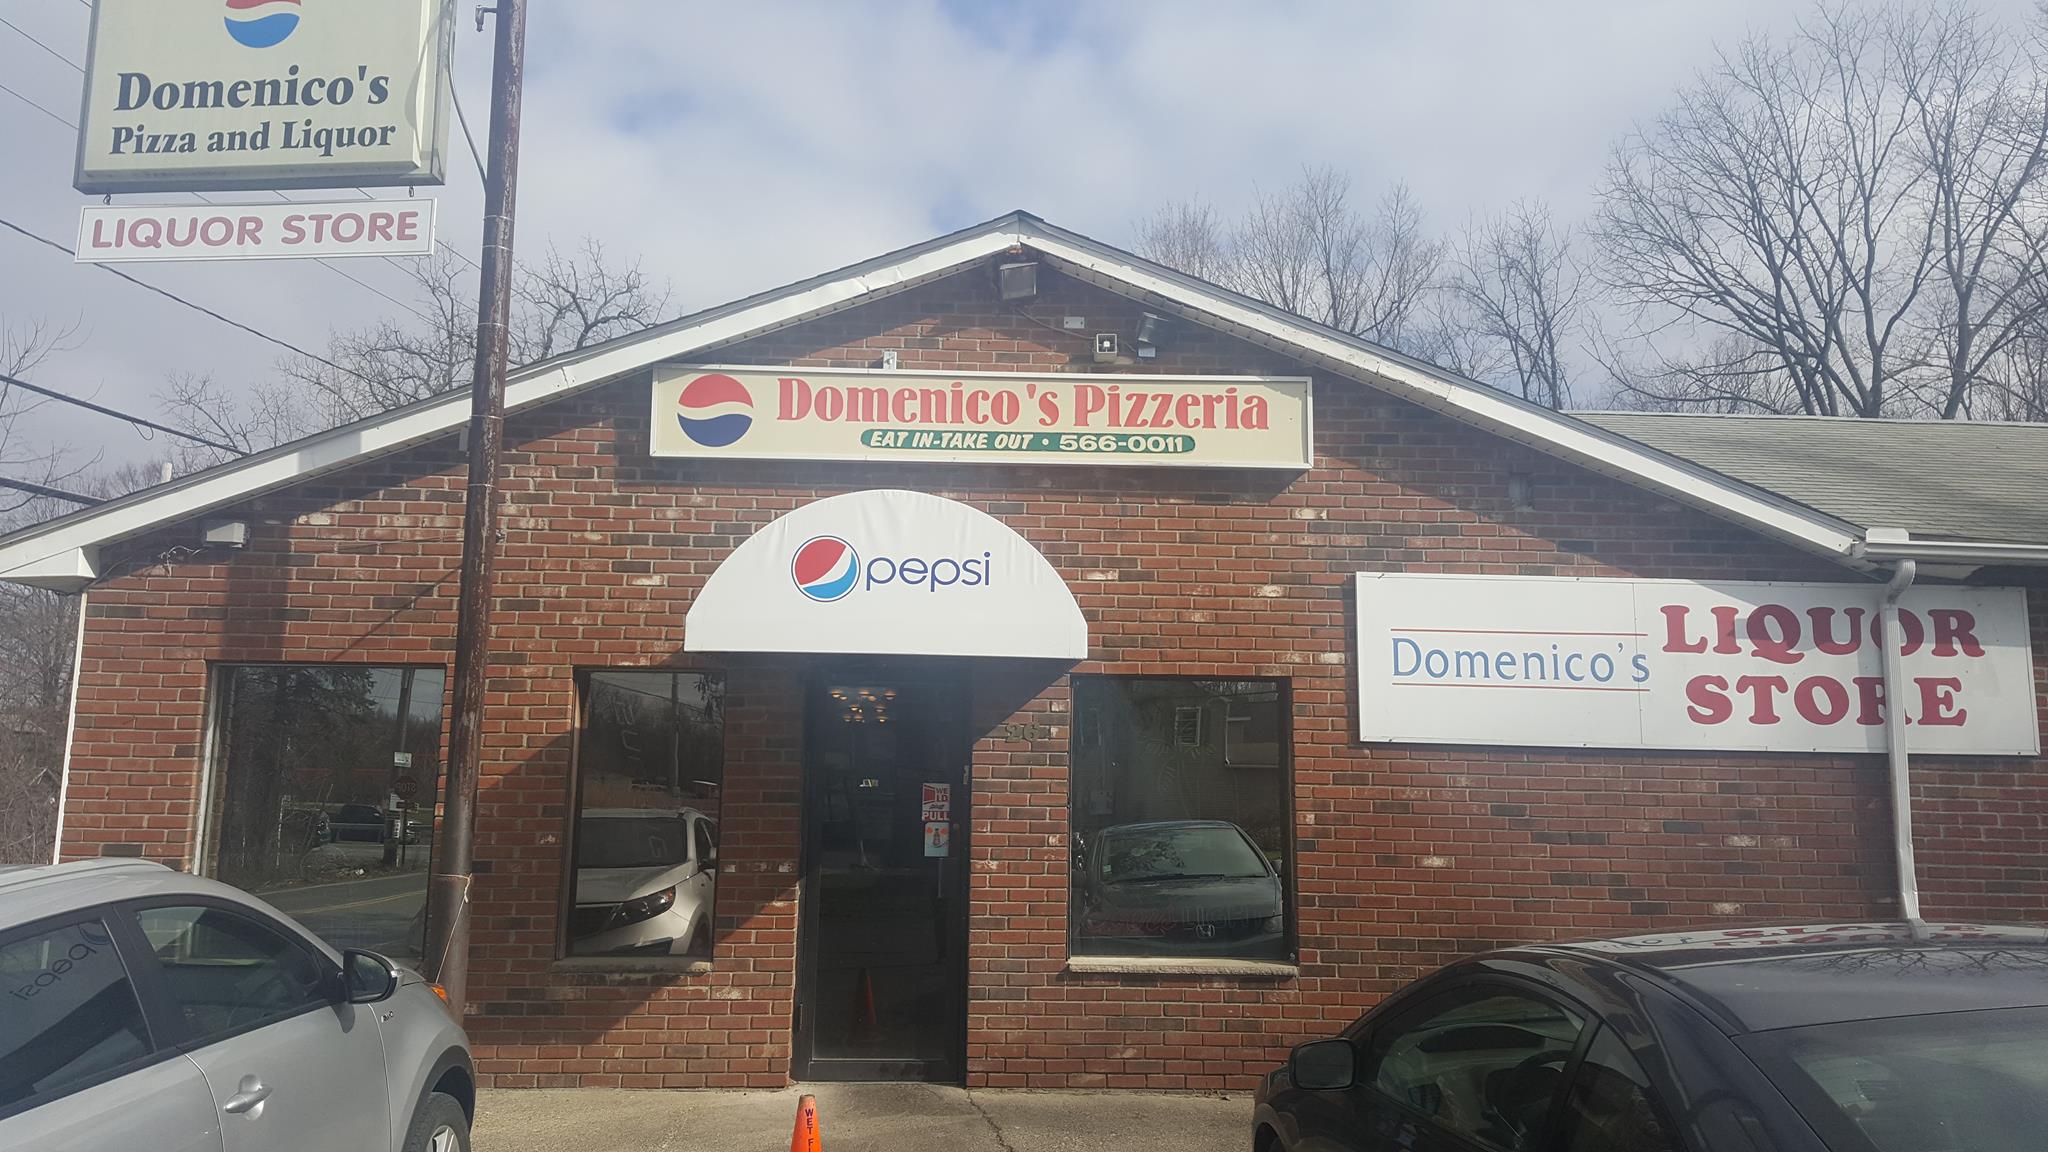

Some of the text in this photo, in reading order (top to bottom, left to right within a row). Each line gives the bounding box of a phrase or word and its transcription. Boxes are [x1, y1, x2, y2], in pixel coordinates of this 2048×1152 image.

[113, 64, 389, 111] Domenico's
[108, 118, 396, 158] Pizza and Liquor
[92, 211, 418, 249] LIQUOR STORE
[776, 378, 1269, 431] Domenico's Pizzeria
[870, 431, 1184, 452] EAT IN-TAKE OUT 566-0011
[865, 551, 991, 592] pepsi
[1660, 604, 1986, 664] LIQUOR
[1391, 637, 1650, 684] Domenico's
[1685, 675, 1967, 726] STORE
[922, 811, 950, 821] PULL
[805, 1108, 814, 1135] WET
